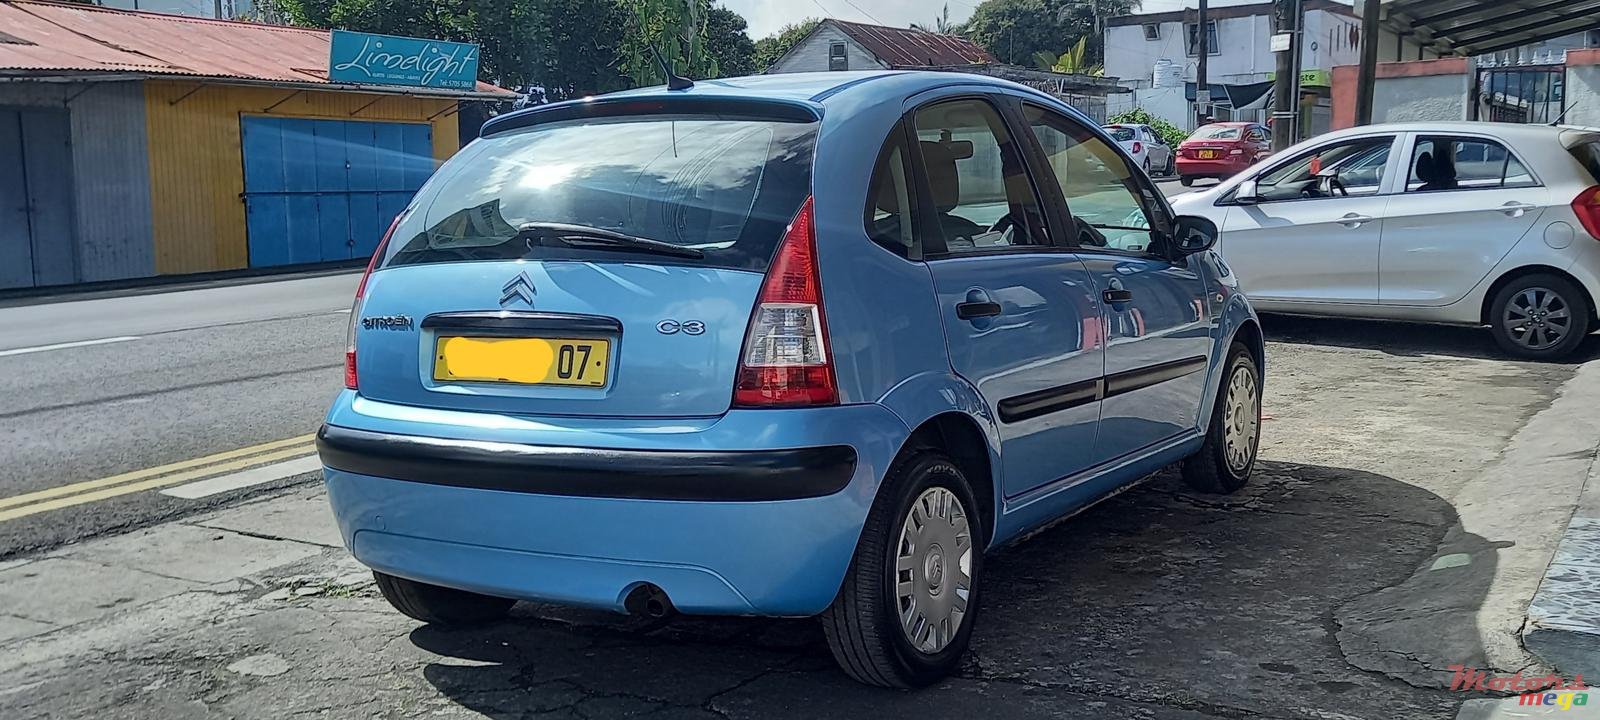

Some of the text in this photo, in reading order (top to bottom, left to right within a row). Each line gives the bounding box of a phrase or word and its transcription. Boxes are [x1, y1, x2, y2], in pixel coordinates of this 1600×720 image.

[335, 36, 476, 85] Limelight
[656, 319, 706, 336] C3
[557, 344, 592, 380] 07
